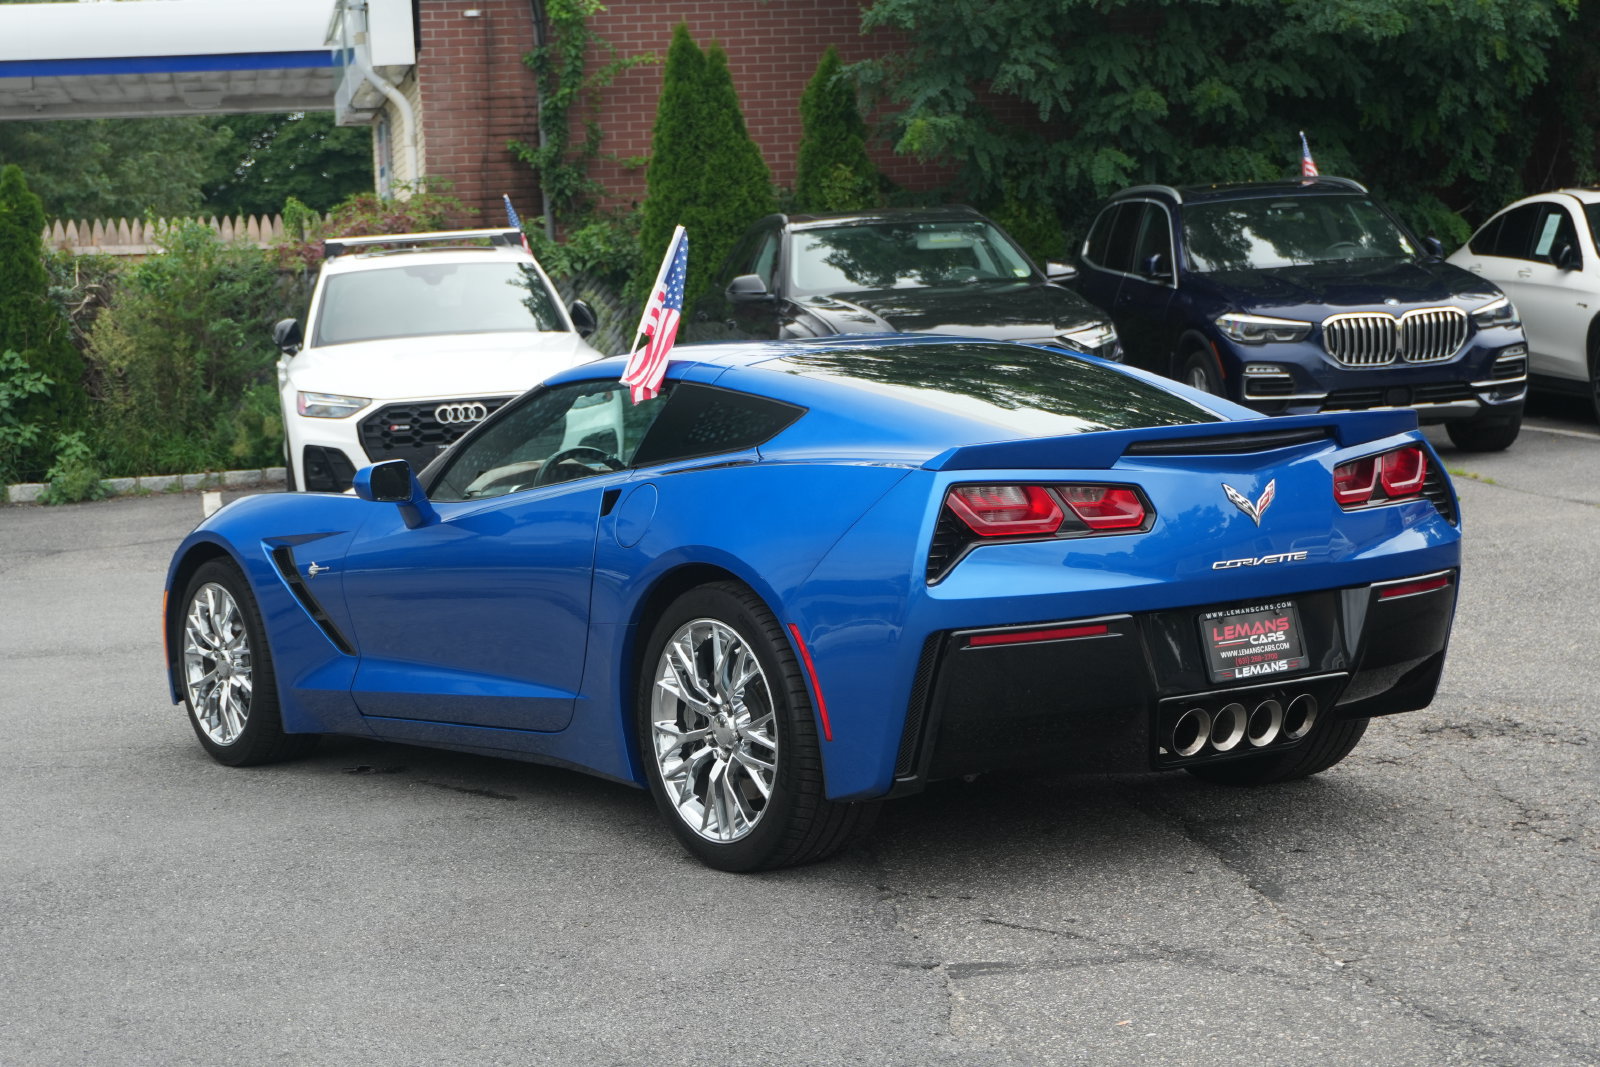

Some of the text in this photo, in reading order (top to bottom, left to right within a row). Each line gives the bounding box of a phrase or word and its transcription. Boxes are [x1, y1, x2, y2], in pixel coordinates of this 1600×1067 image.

[1212, 551, 1308, 569] CORVETTE
[1206, 602, 1292, 619] WWW.LEMANSCARS.COM
[1213, 617, 1290, 641] LEMANS
[1250, 631, 1286, 645] CARS
[1220, 642, 1290, 658] WWW.LEMANSCARS.COM
[1235, 660, 1288, 678] LEMANS
